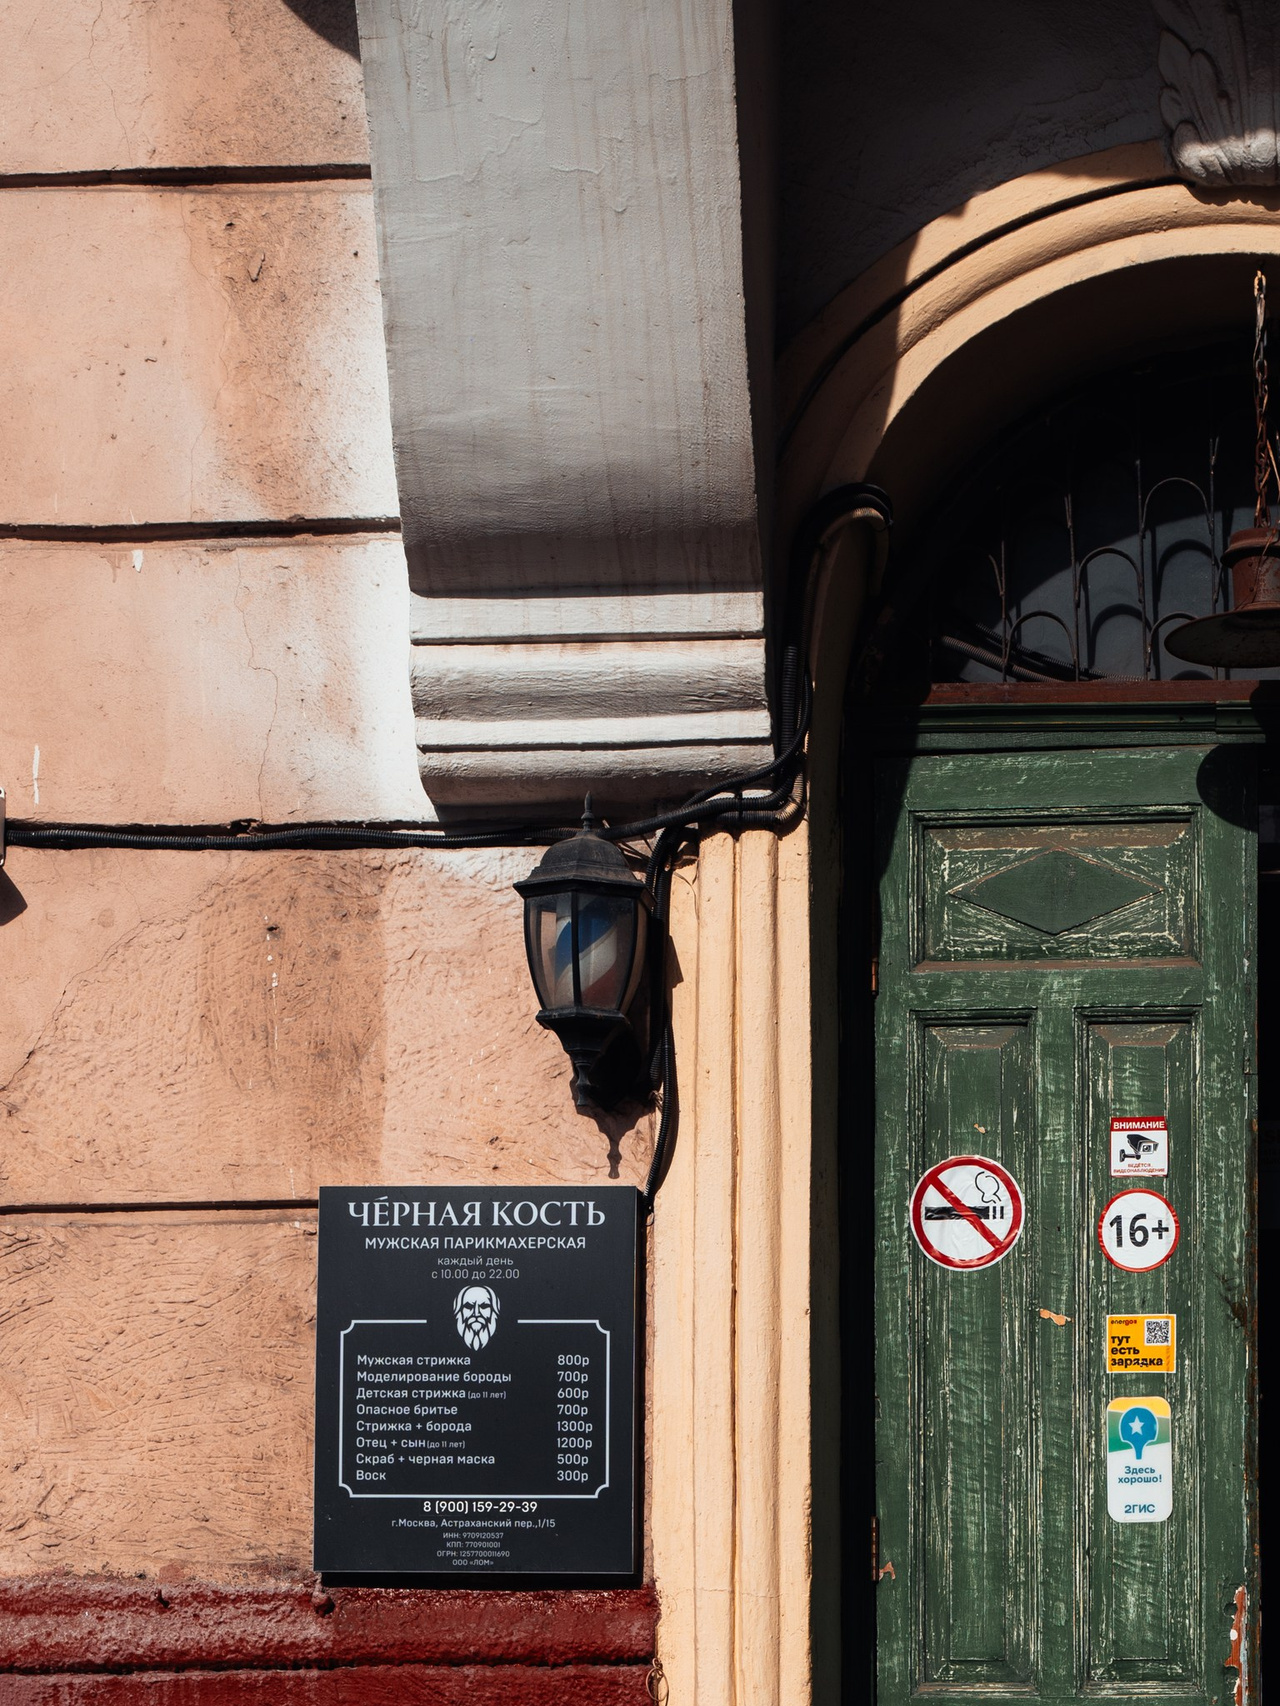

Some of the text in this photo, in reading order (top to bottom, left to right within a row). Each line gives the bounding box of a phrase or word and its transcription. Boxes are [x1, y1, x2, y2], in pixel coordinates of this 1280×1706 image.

[1114, 1121, 1164, 1129] ВНИМАНИЕ
[492, 1201, 605, 1226] КОСТЬ
[1109, 1214, 1169, 1247] 16+
[366, 1237, 585, 1249] МУЖСКАЯ ПАРИКМАХЕРСКАЯ
[438, 1256, 513, 1266] каждый день
[432, 1269, 519, 1280] с 10.00 до 22.00
[1111, 1336, 1130, 1346] тут
[358, 1355, 589, 1367] Мужская стрижка 800р
[1111, 1358, 1163, 1368] зарядка
[357, 1371, 588, 1383] Моделирование бороды 700р
[356, 1388, 408, 1399] Детская
[412, 1390, 465, 1400] стрижка
[468, 1391, 481, 1399] (до
[490, 1391, 506, 1399] лет)
[558, 1388, 588, 1400] 600р
[357, 1404, 588, 1417] Опасное бритье 700р
[357, 1421, 411, 1433] Стрижка
[426, 1421, 471, 1433] борода
[557, 1421, 592, 1433] 1300р
[357, 1437, 387, 1449] Отец
[557, 1437, 592, 1450] 1200р
[356, 1453, 394, 1465] Скраб
[409, 1456, 453, 1466] черная
[458, 1456, 495, 1464] маска
[558, 1454, 588, 1466] 500р
[1124, 1465, 1155, 1475] Здесь
[357, 1470, 588, 1483] Воск 300р
[1118, 1474, 1162, 1484] хорошо!
[424, 1501, 537, 1514] 8 (900) 159-29-39
[1124, 1504, 1155, 1514] 2ГИС
[441, 1519, 511, 1528] Астраханский
